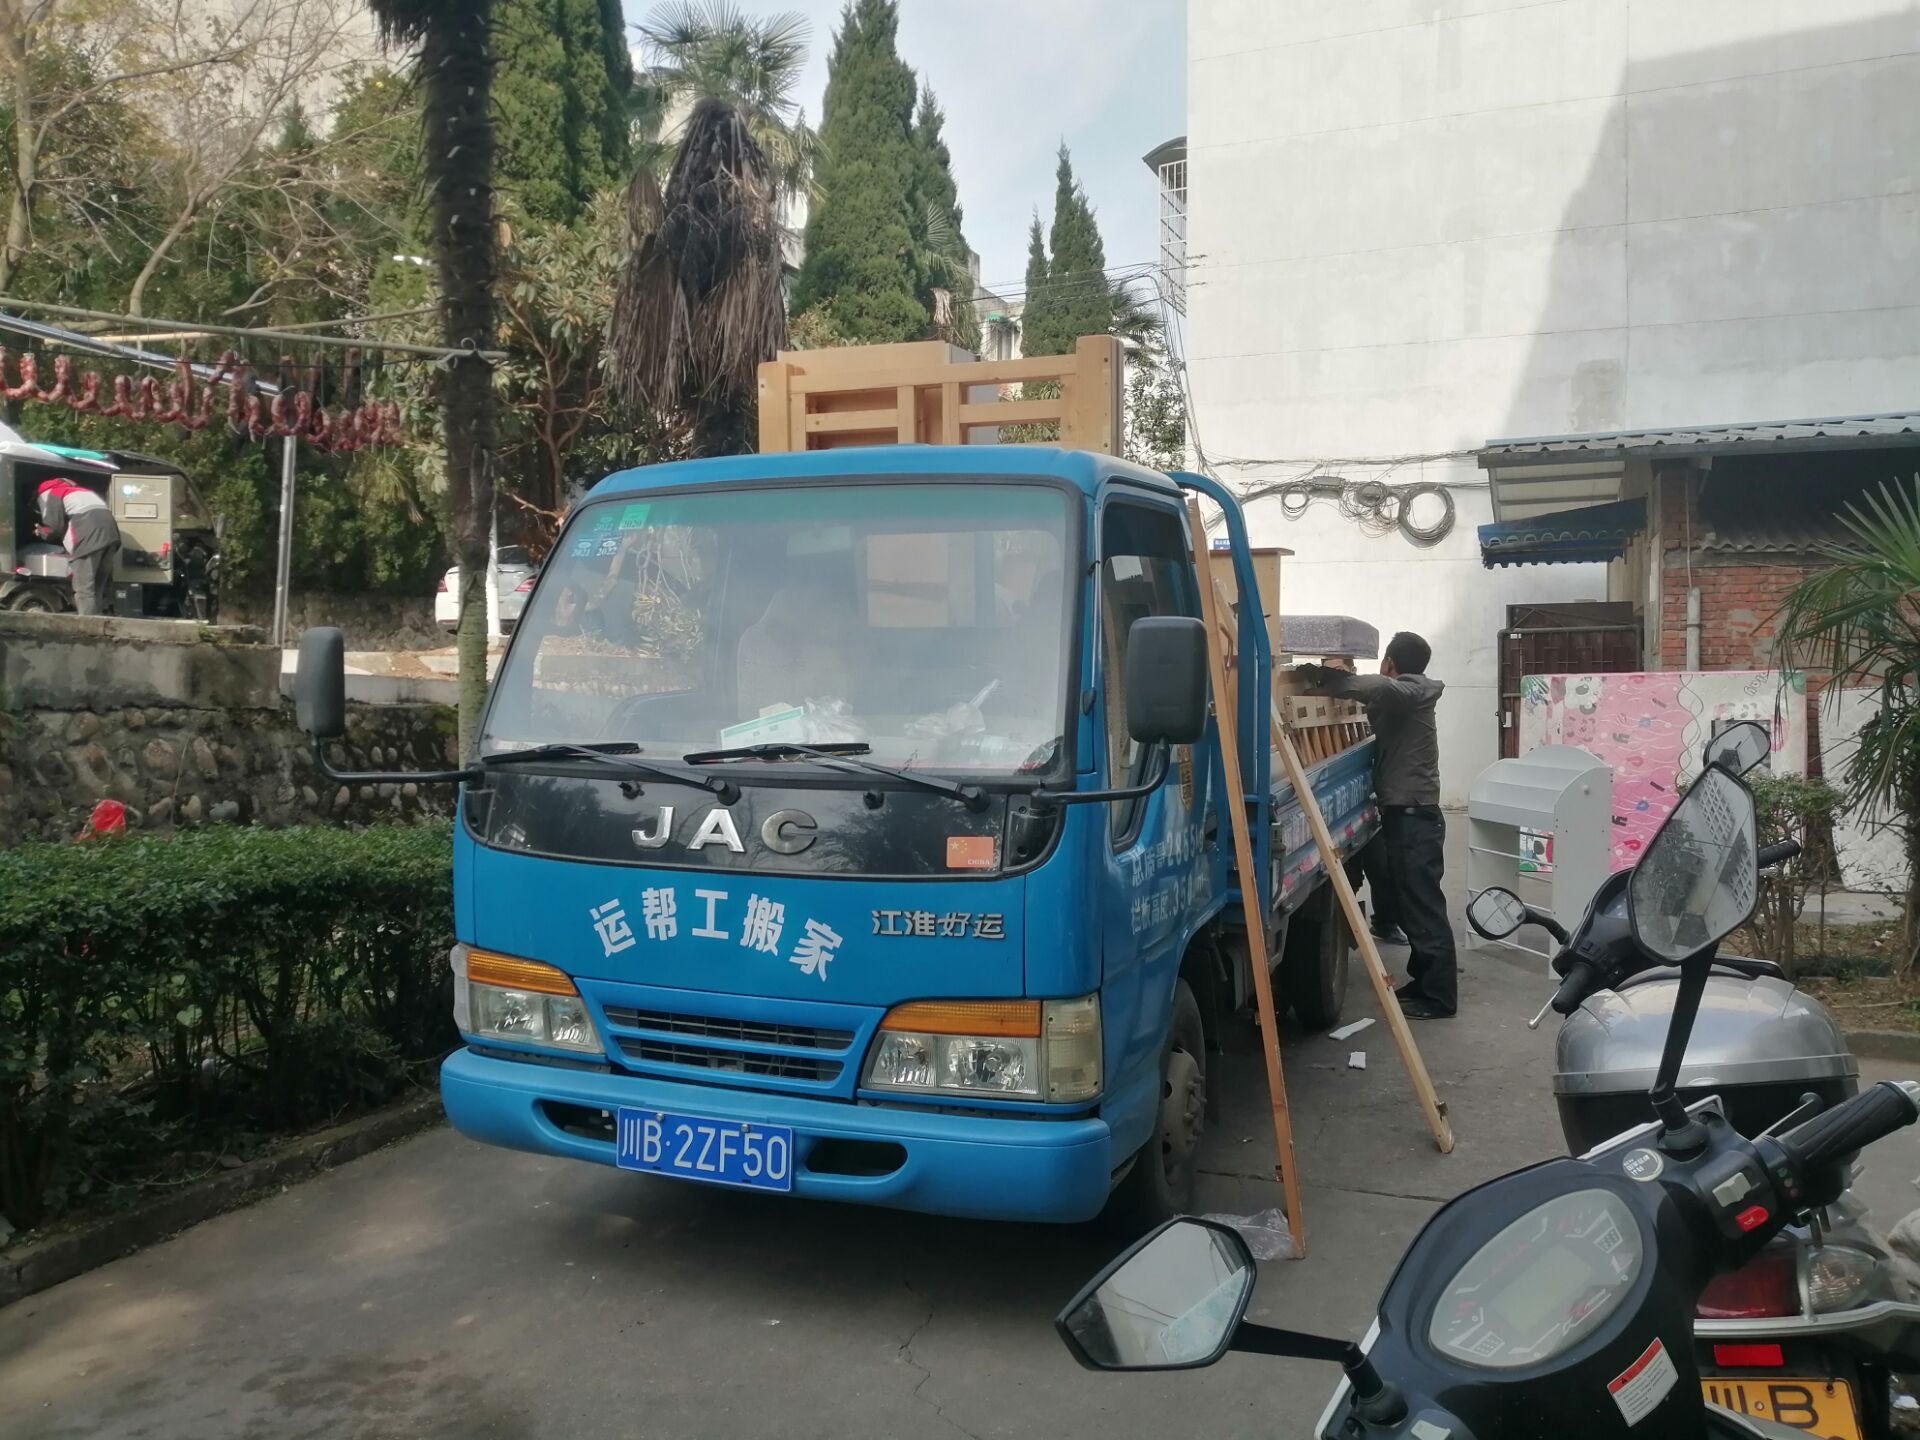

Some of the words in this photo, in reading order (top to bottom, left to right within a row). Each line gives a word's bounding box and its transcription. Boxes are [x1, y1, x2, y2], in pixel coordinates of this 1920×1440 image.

[631, 805, 819, 855] JAC
[871, 909, 1006, 939] 江淮好运
